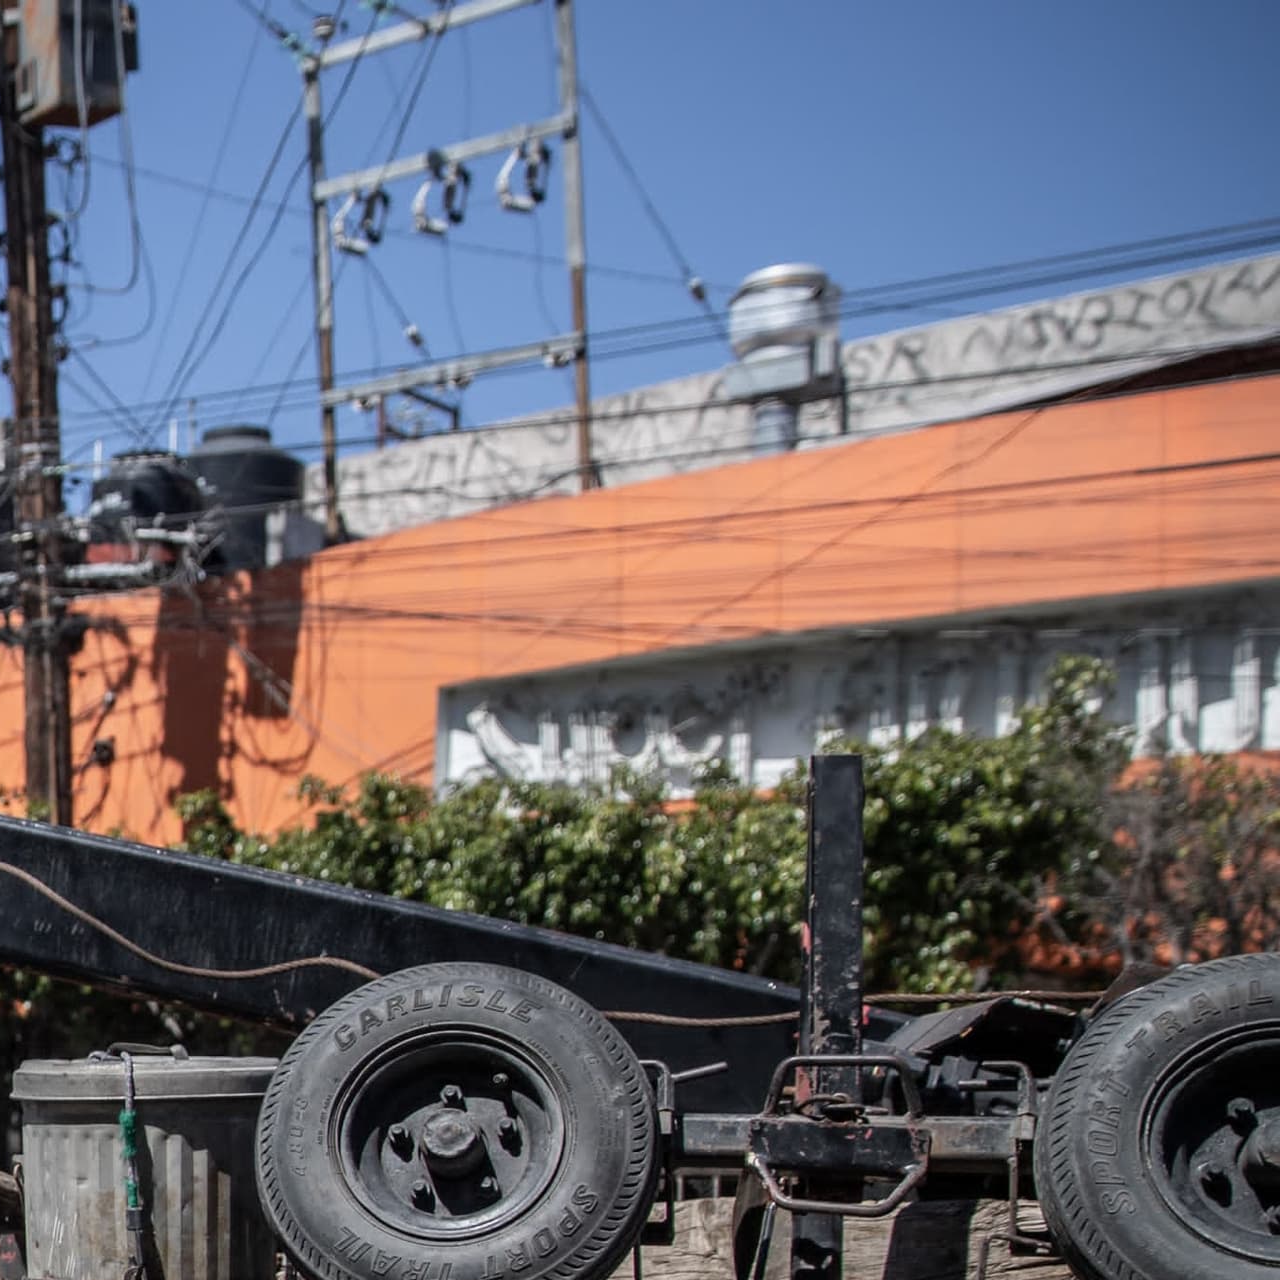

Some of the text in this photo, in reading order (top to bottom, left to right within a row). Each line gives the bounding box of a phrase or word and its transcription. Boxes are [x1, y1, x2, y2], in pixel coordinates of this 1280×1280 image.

[333, 982, 544, 1054] CARLISLE
[1088, 980, 1273, 1217] SPORT TRAIL
